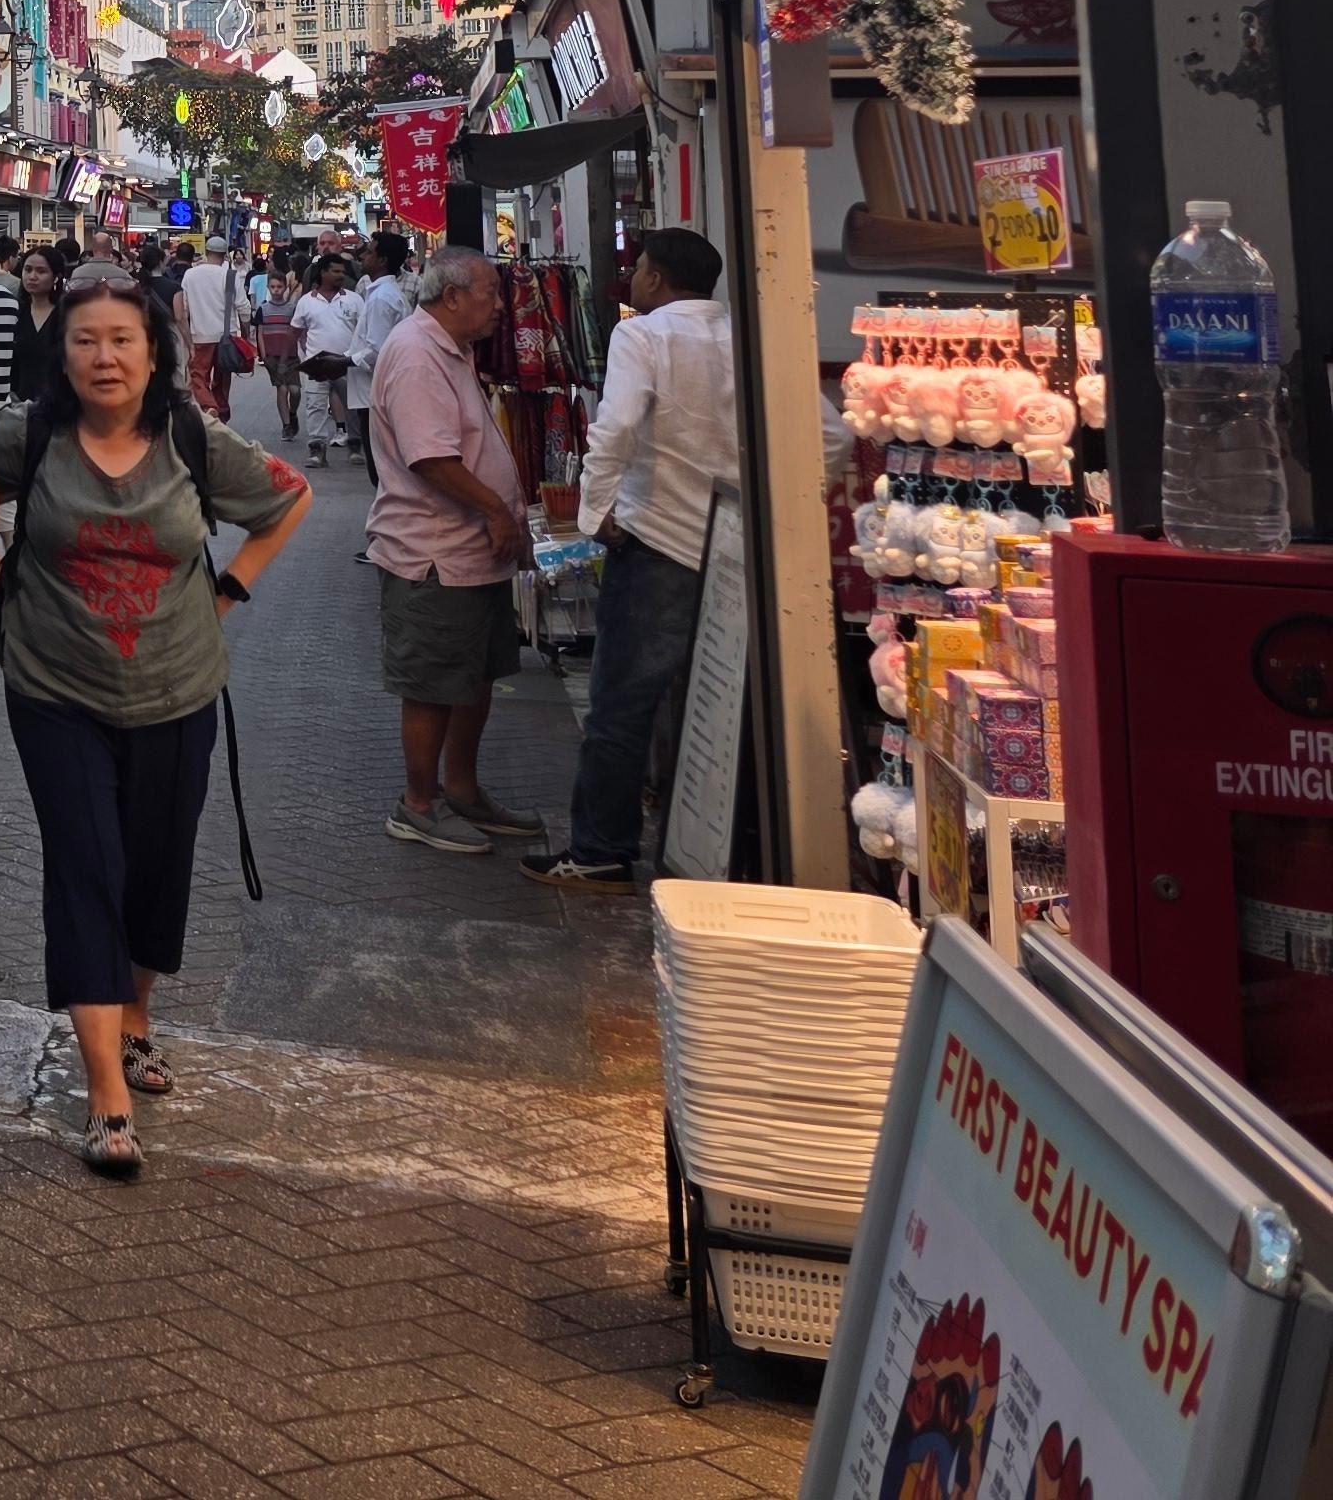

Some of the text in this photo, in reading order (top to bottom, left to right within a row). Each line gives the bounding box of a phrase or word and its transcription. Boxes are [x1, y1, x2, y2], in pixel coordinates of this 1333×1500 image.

[407, 127, 443, 198] 吉祥苑
[983, 156, 1047, 176] SINGAPORE
[996, 174, 1039, 201] SALE
[985, 211, 1002, 248] 2
[1168, 308, 1249, 331] DASANI
[935, 1032, 1020, 1174] FIRST
[1013, 1114, 1151, 1336] BEAUTY
